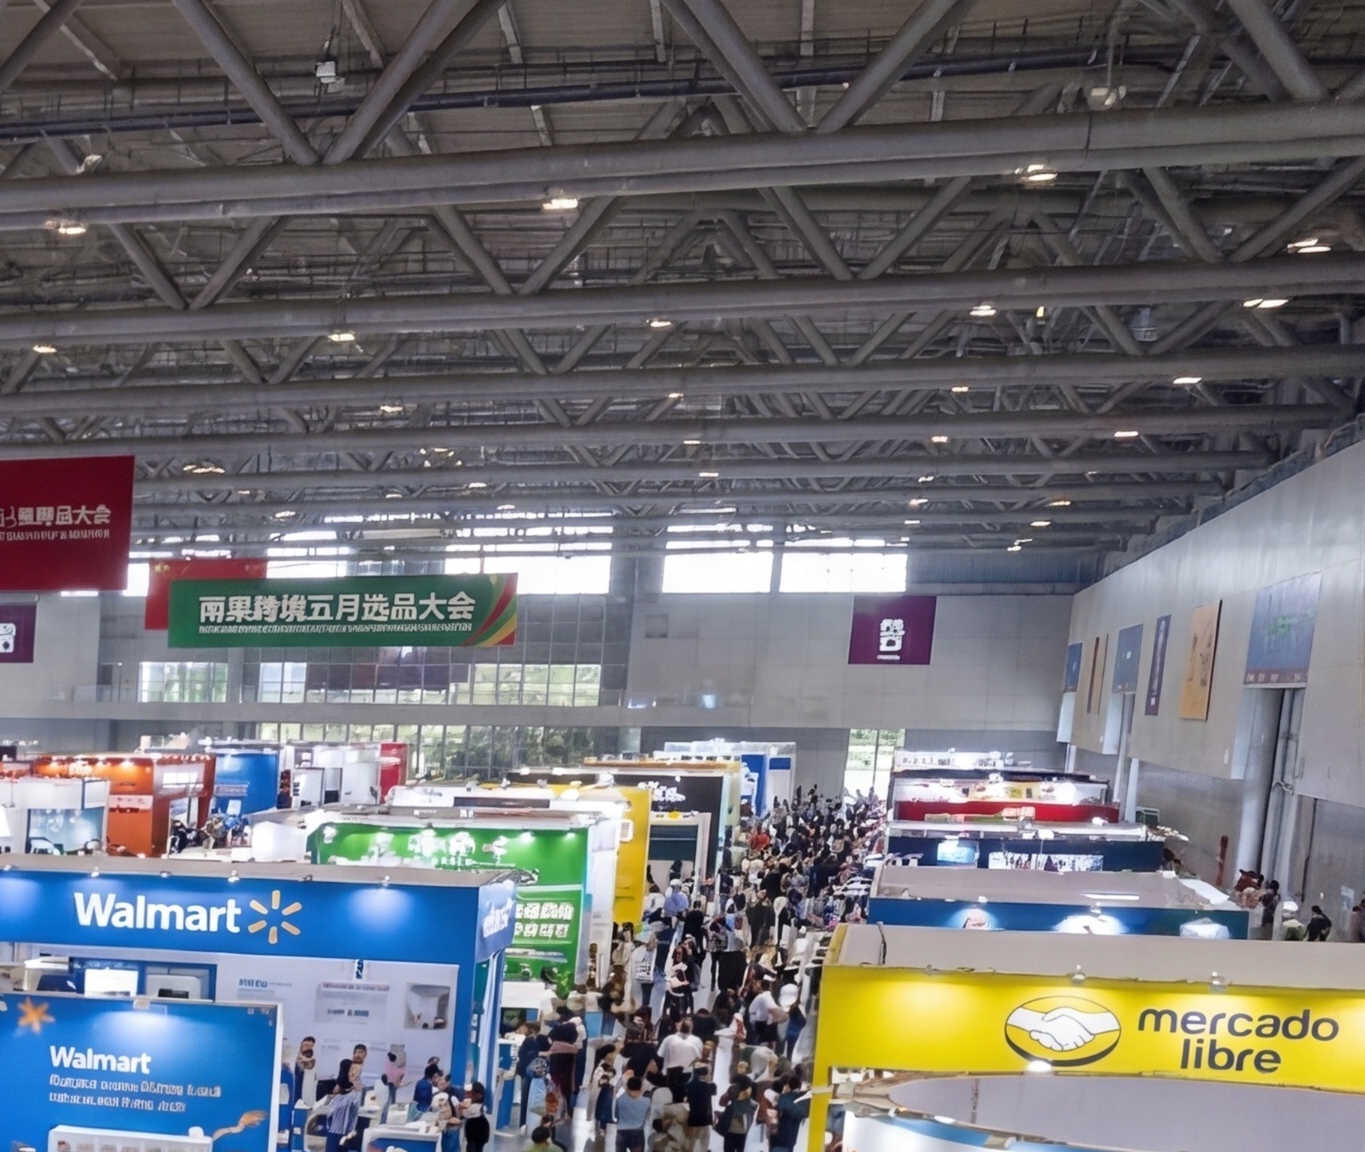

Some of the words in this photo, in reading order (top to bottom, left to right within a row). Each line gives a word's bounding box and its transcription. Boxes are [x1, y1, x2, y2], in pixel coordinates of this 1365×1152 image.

[73, 892, 241, 934] Walmart
[1138, 1007, 1340, 1042] mercado
[49, 1045, 151, 1074] Walmart
[1181, 1039, 1282, 1074] libre
